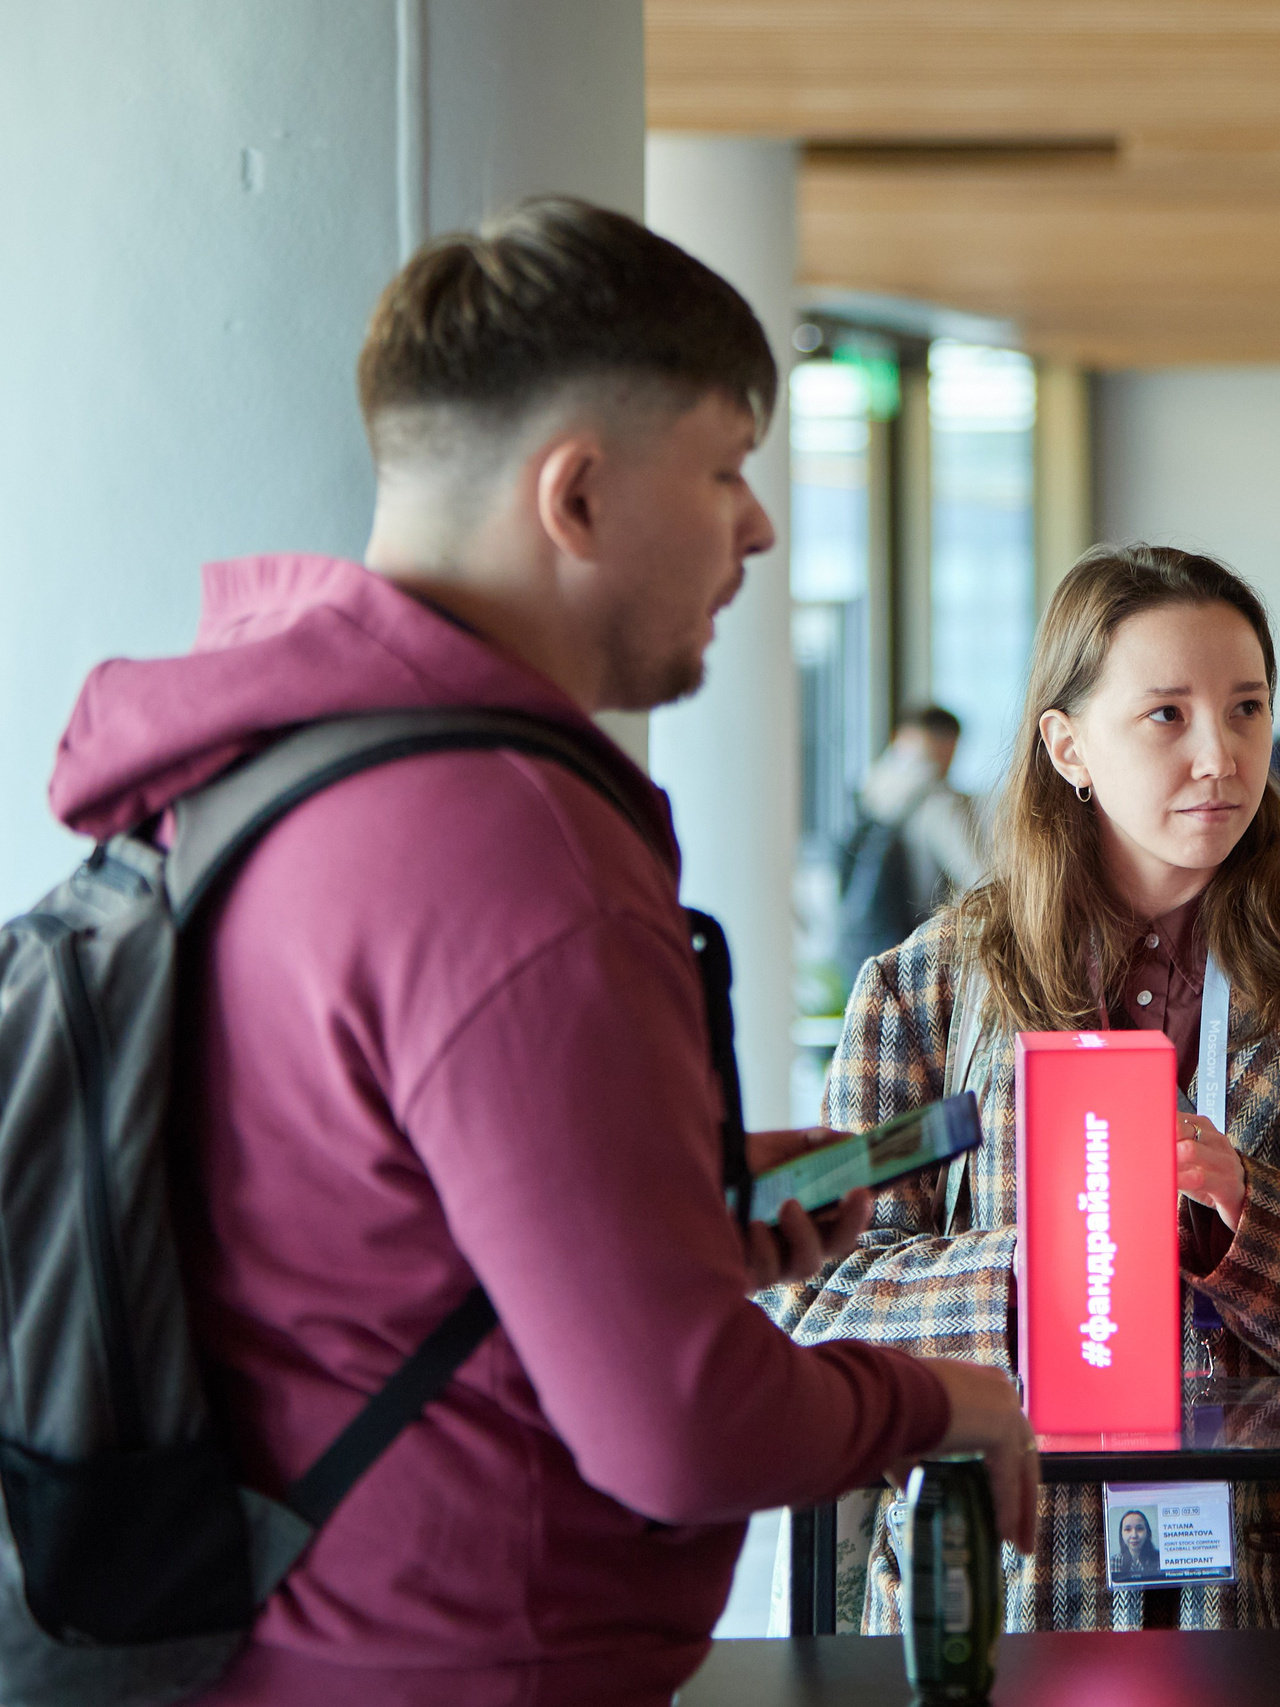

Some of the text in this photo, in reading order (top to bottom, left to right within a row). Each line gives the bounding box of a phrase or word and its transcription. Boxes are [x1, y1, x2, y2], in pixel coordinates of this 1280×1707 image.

[1206, 1020, 1221, 1078] Moscow
[1078, 1111, 1118, 1368] #фандрайзинг
[1163, 1530, 1213, 1538] SHAMRATOVA
[1165, 1557, 1213, 1565] PARTICIPANT
